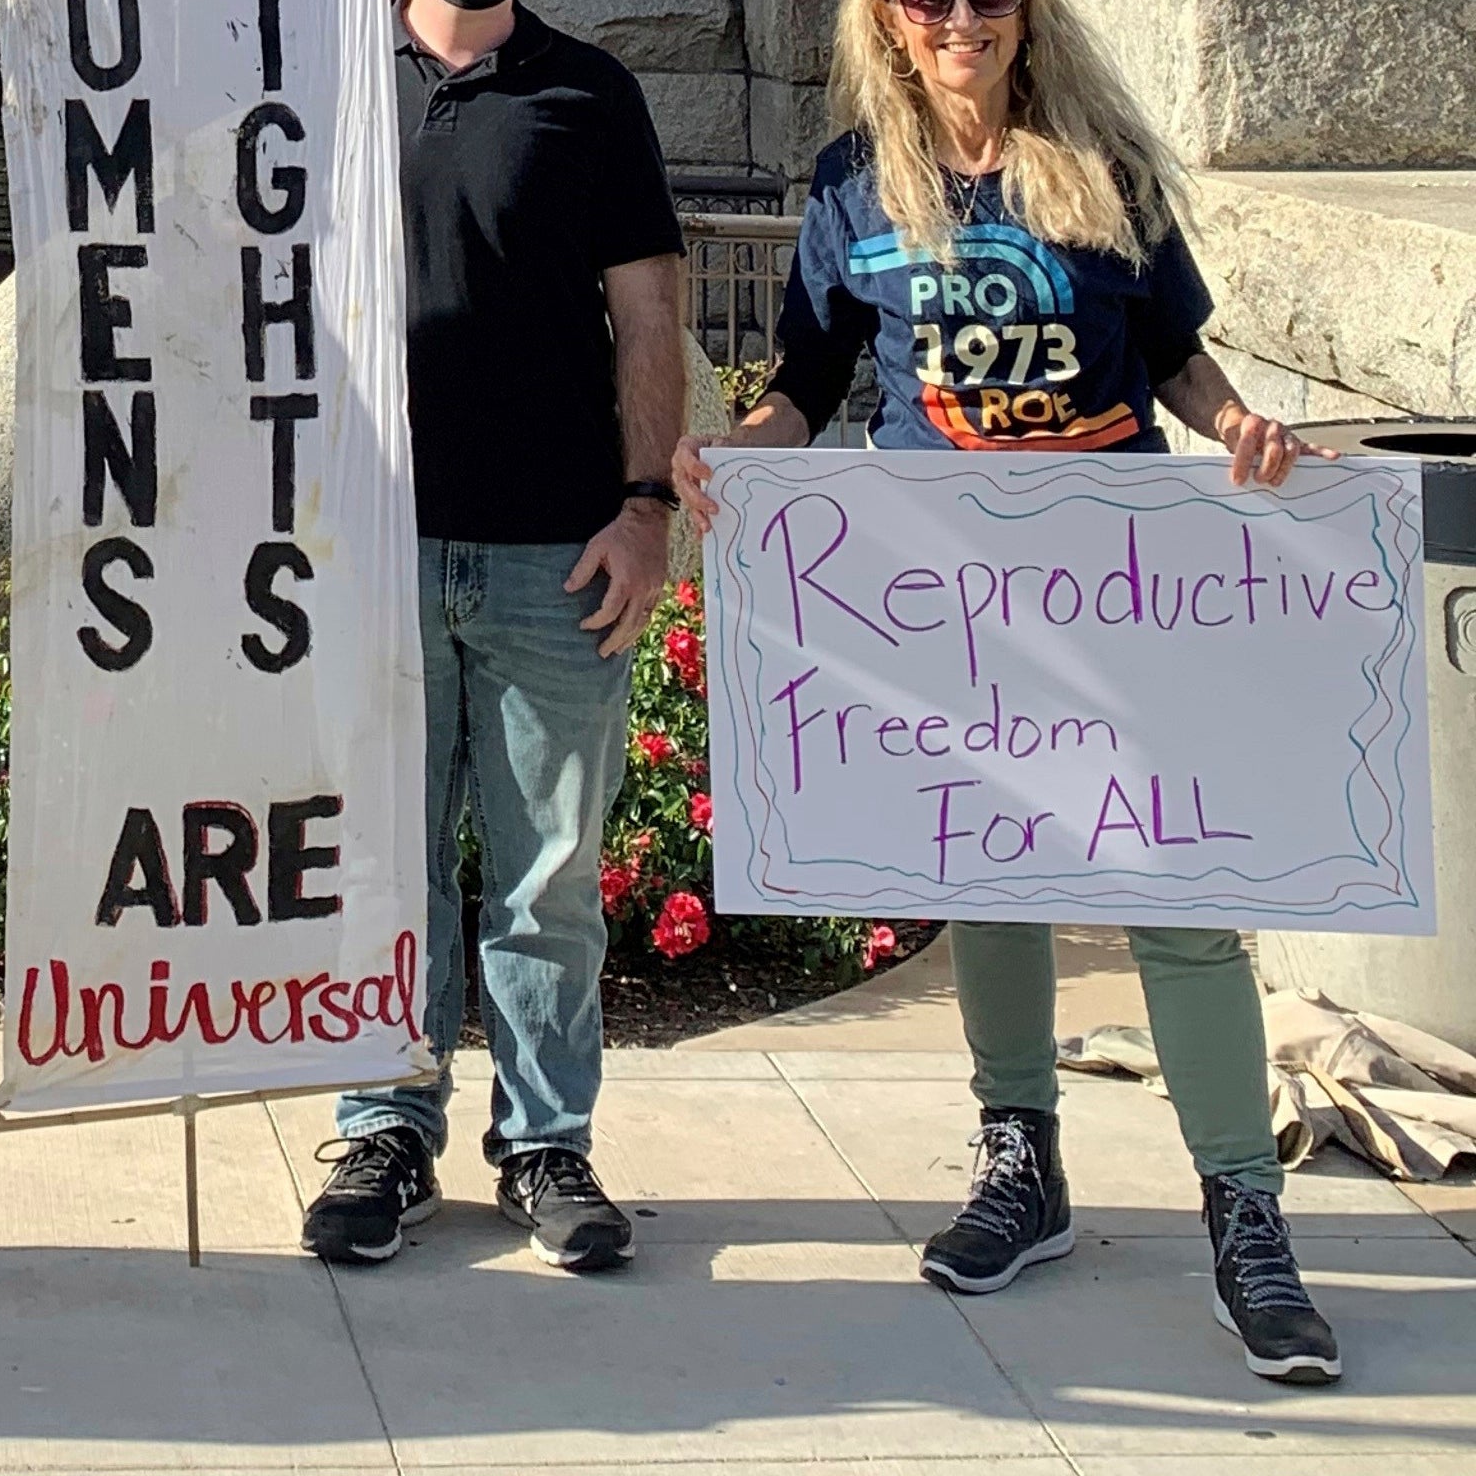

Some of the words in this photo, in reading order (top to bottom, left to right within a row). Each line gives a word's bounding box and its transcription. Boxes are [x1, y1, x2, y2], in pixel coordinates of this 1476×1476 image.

[911, 274, 1017, 316] PRO
[914, 324, 1081, 386] 1973
[980, 389, 1077, 429] ROE
[762, 493, 1394, 686] Reproductive
[771, 667, 1117, 794] Freedom
[95, 794, 343, 927] ARE
[918, 780, 1055, 884] For
[1087, 774, 1252, 861] ALL
[17, 930, 421, 1065] Universal
